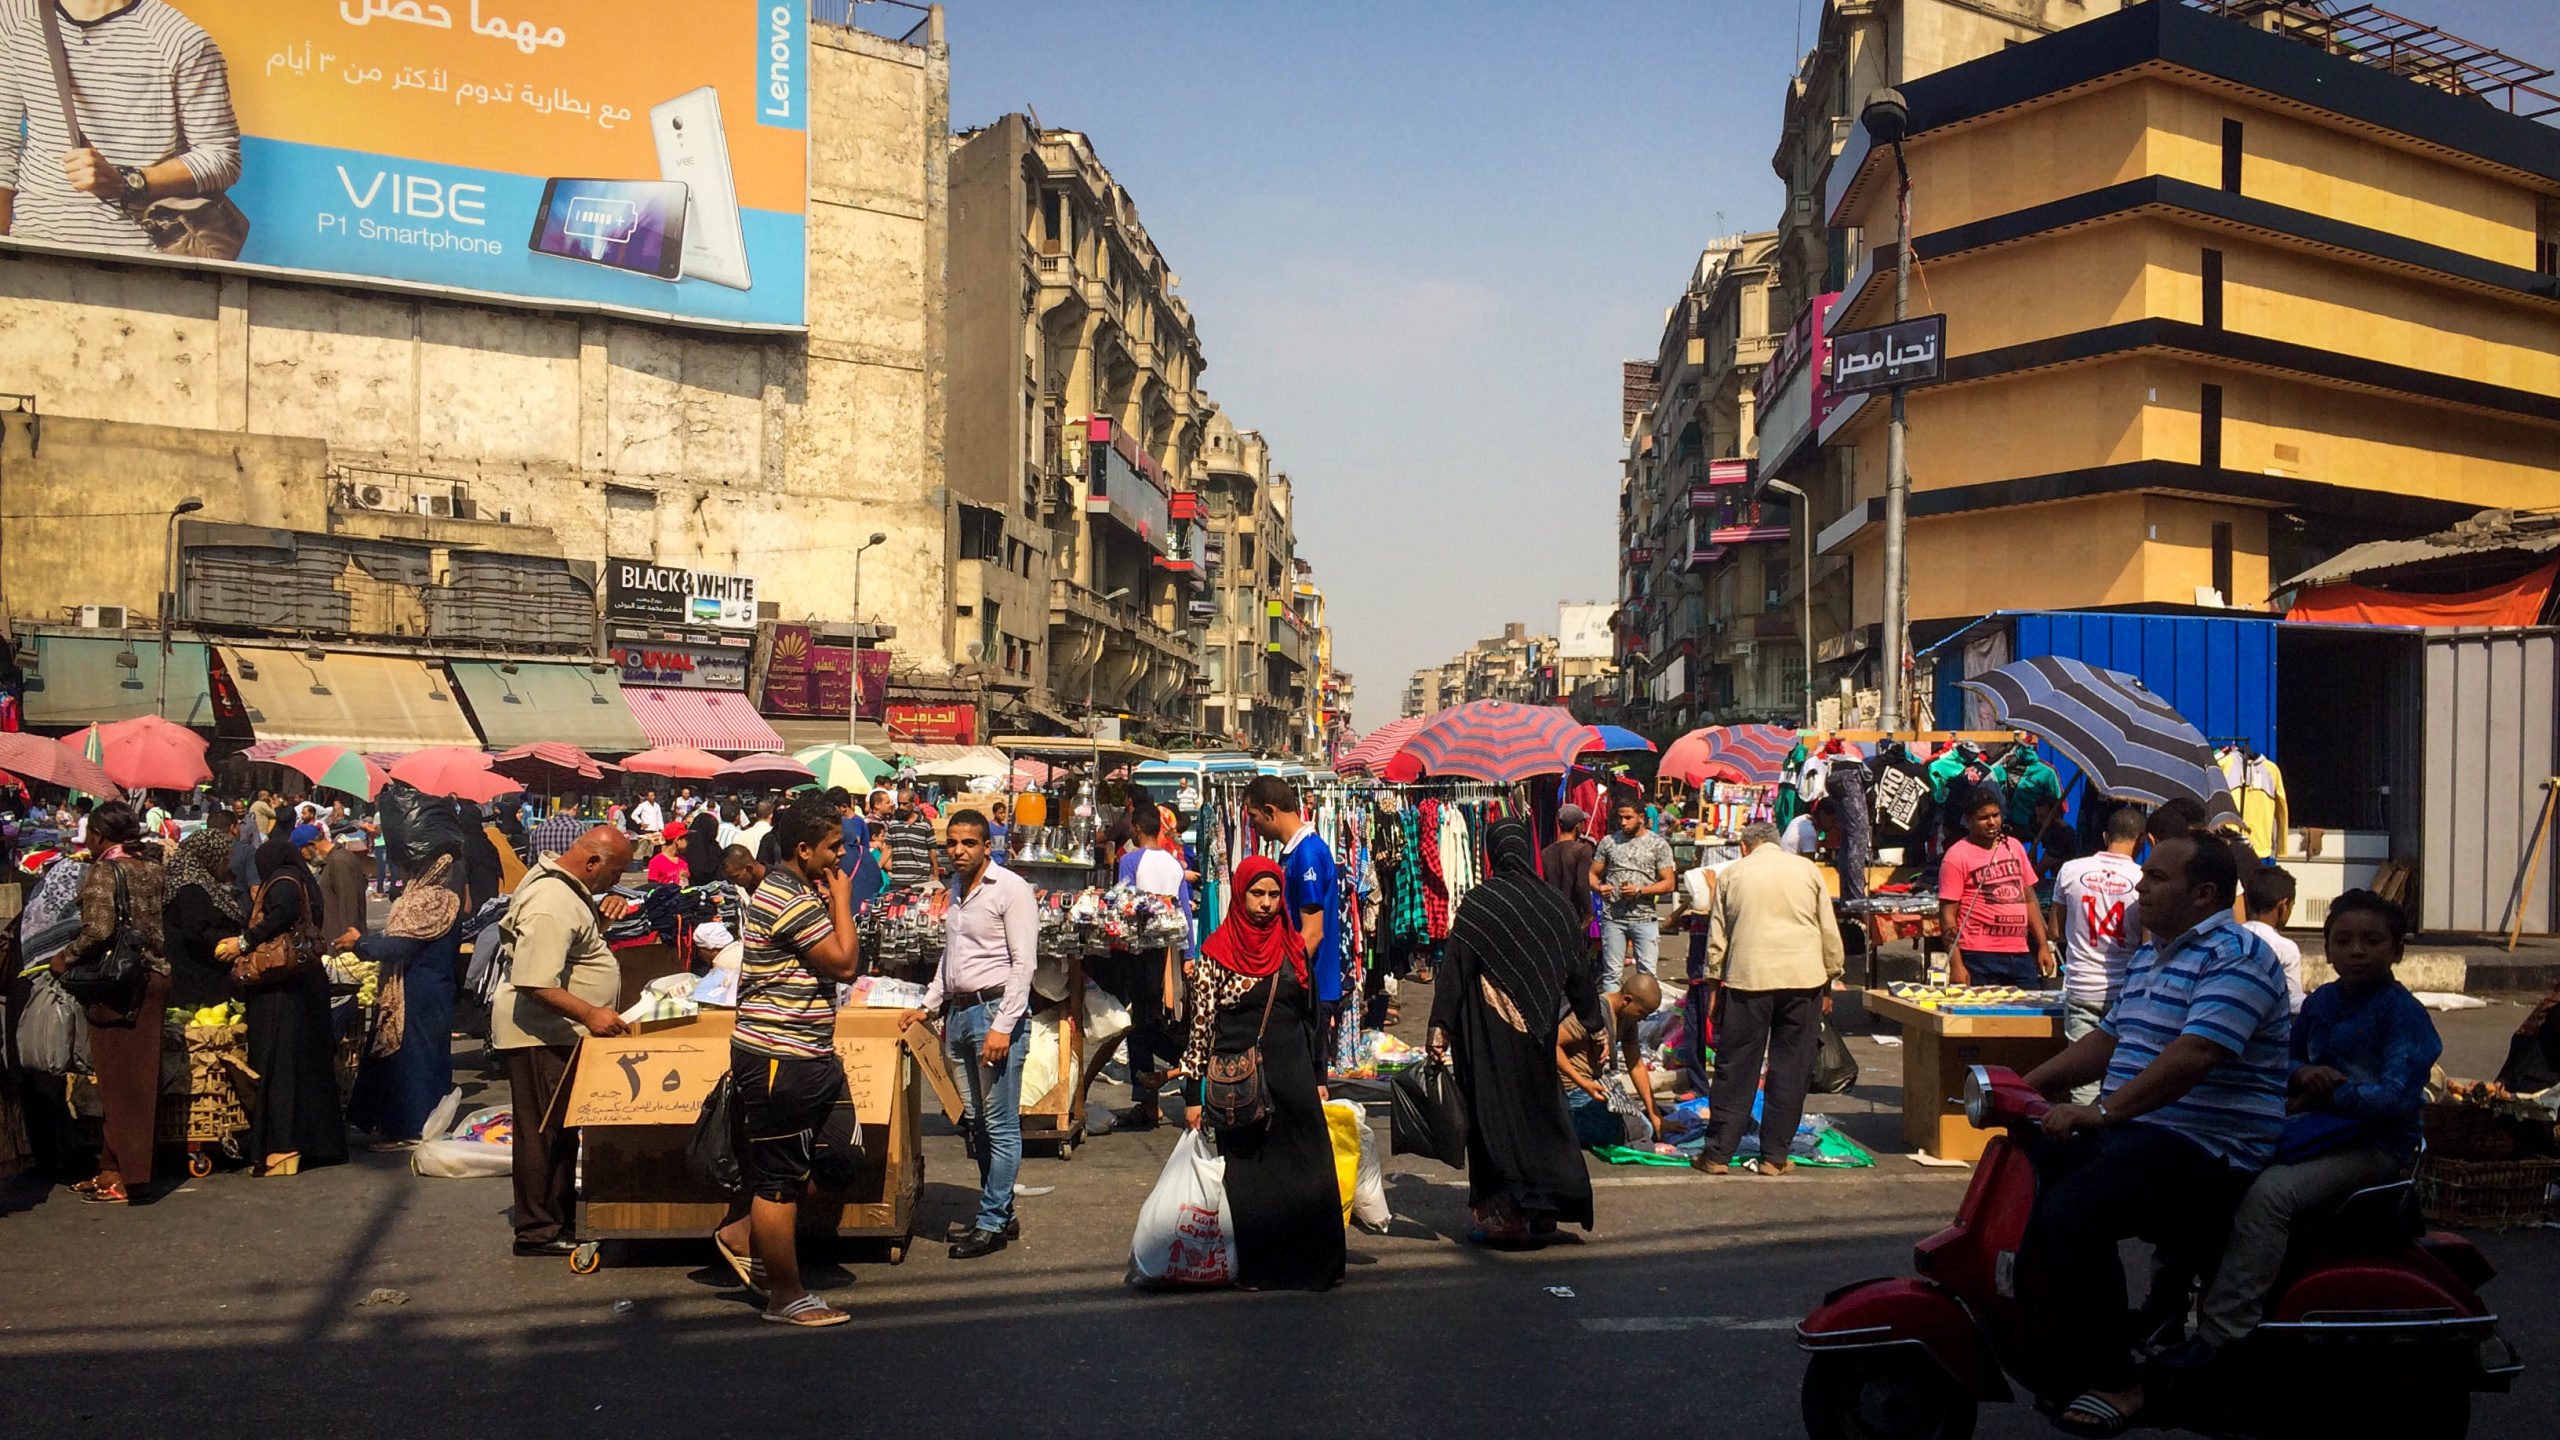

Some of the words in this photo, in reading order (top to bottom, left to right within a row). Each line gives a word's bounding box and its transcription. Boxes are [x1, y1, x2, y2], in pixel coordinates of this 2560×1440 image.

[471, 0, 566, 54] مهما
[265, 40, 312, 76] أيام
[319, 53, 336, 73] ٣
[343, 66, 383, 85] من
[766, 6, 791, 118] Lenovo
[456, 82, 512, 105] تدوم
[520, 84, 591, 121] بطارية
[598, 104, 631, 129] مع
[336, 165, 486, 226] VIBE
[318, 212, 347, 235] P1
[358, 218, 502, 256] Smartphone
[1836, 350, 1885, 384] مصر
[621, 565, 680, 593] BLACK
[682, 572, 695, 596] &
[697, 573, 754, 601] WHITE
[895, 710, 956, 726] الحرمين
[1880, 768, 1905, 808] WHO
[2082, 895, 2126, 948] 14
[616, 1051, 681, 1103] ٣٥
